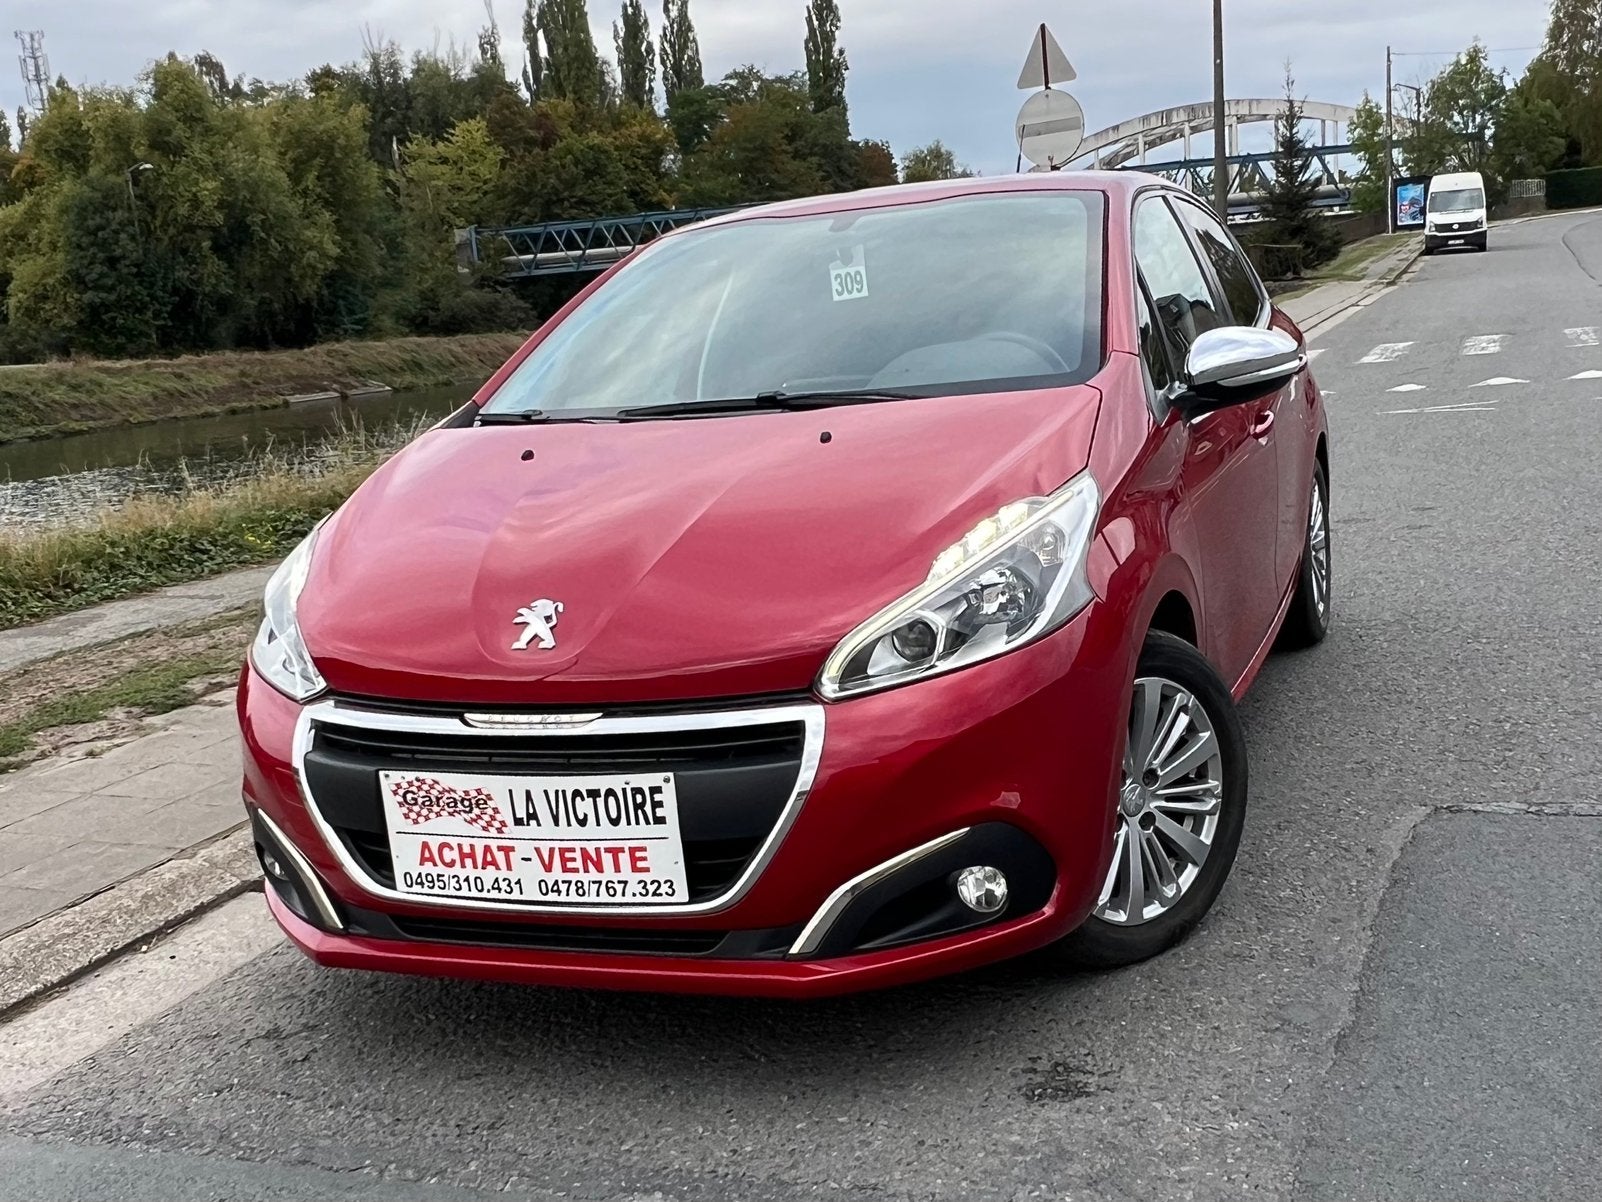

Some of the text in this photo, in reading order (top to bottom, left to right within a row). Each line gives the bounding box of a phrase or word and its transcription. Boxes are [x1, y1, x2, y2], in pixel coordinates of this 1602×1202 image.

[834, 270, 864, 297] 309
[402, 786, 667, 828] Garage LA VICTOIRE
[403, 871, 677, 898] 0495/310.431 0478/767.323
